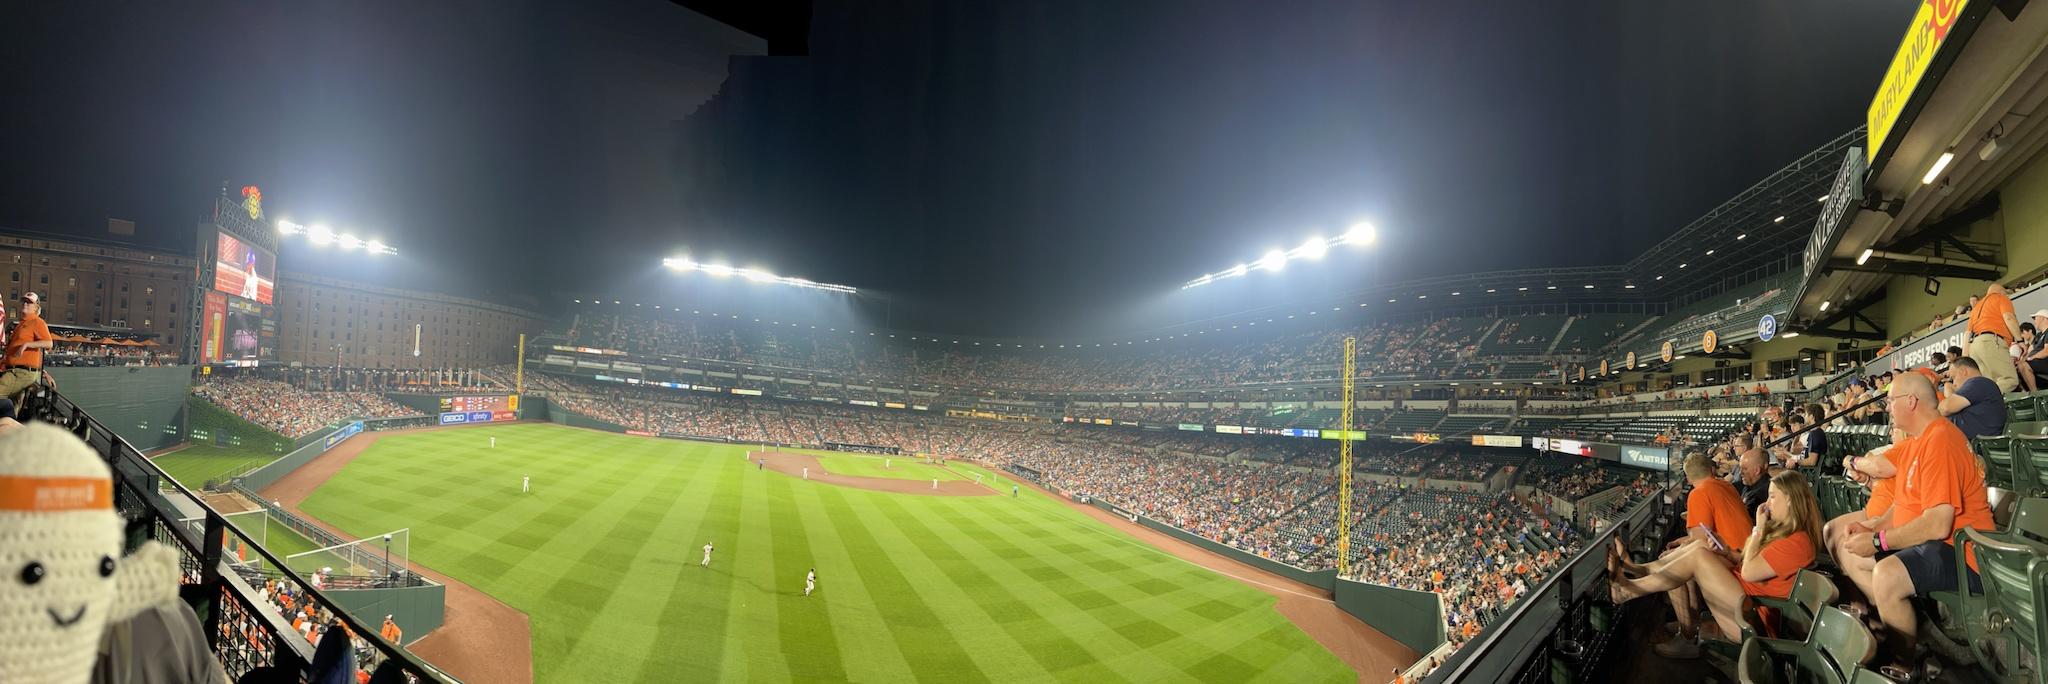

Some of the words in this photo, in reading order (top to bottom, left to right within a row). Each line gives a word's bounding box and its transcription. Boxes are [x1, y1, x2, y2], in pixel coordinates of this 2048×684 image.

[1873, 20, 1930, 139] MARYLAND
[1805, 211, 1827, 277] GANZ
[1706, 336, 1711, 347] 8
[1760, 319, 1772, 336] 42
[1904, 348, 1925, 368] PEPSI
[1925, 339, 1949, 361] ZERO
